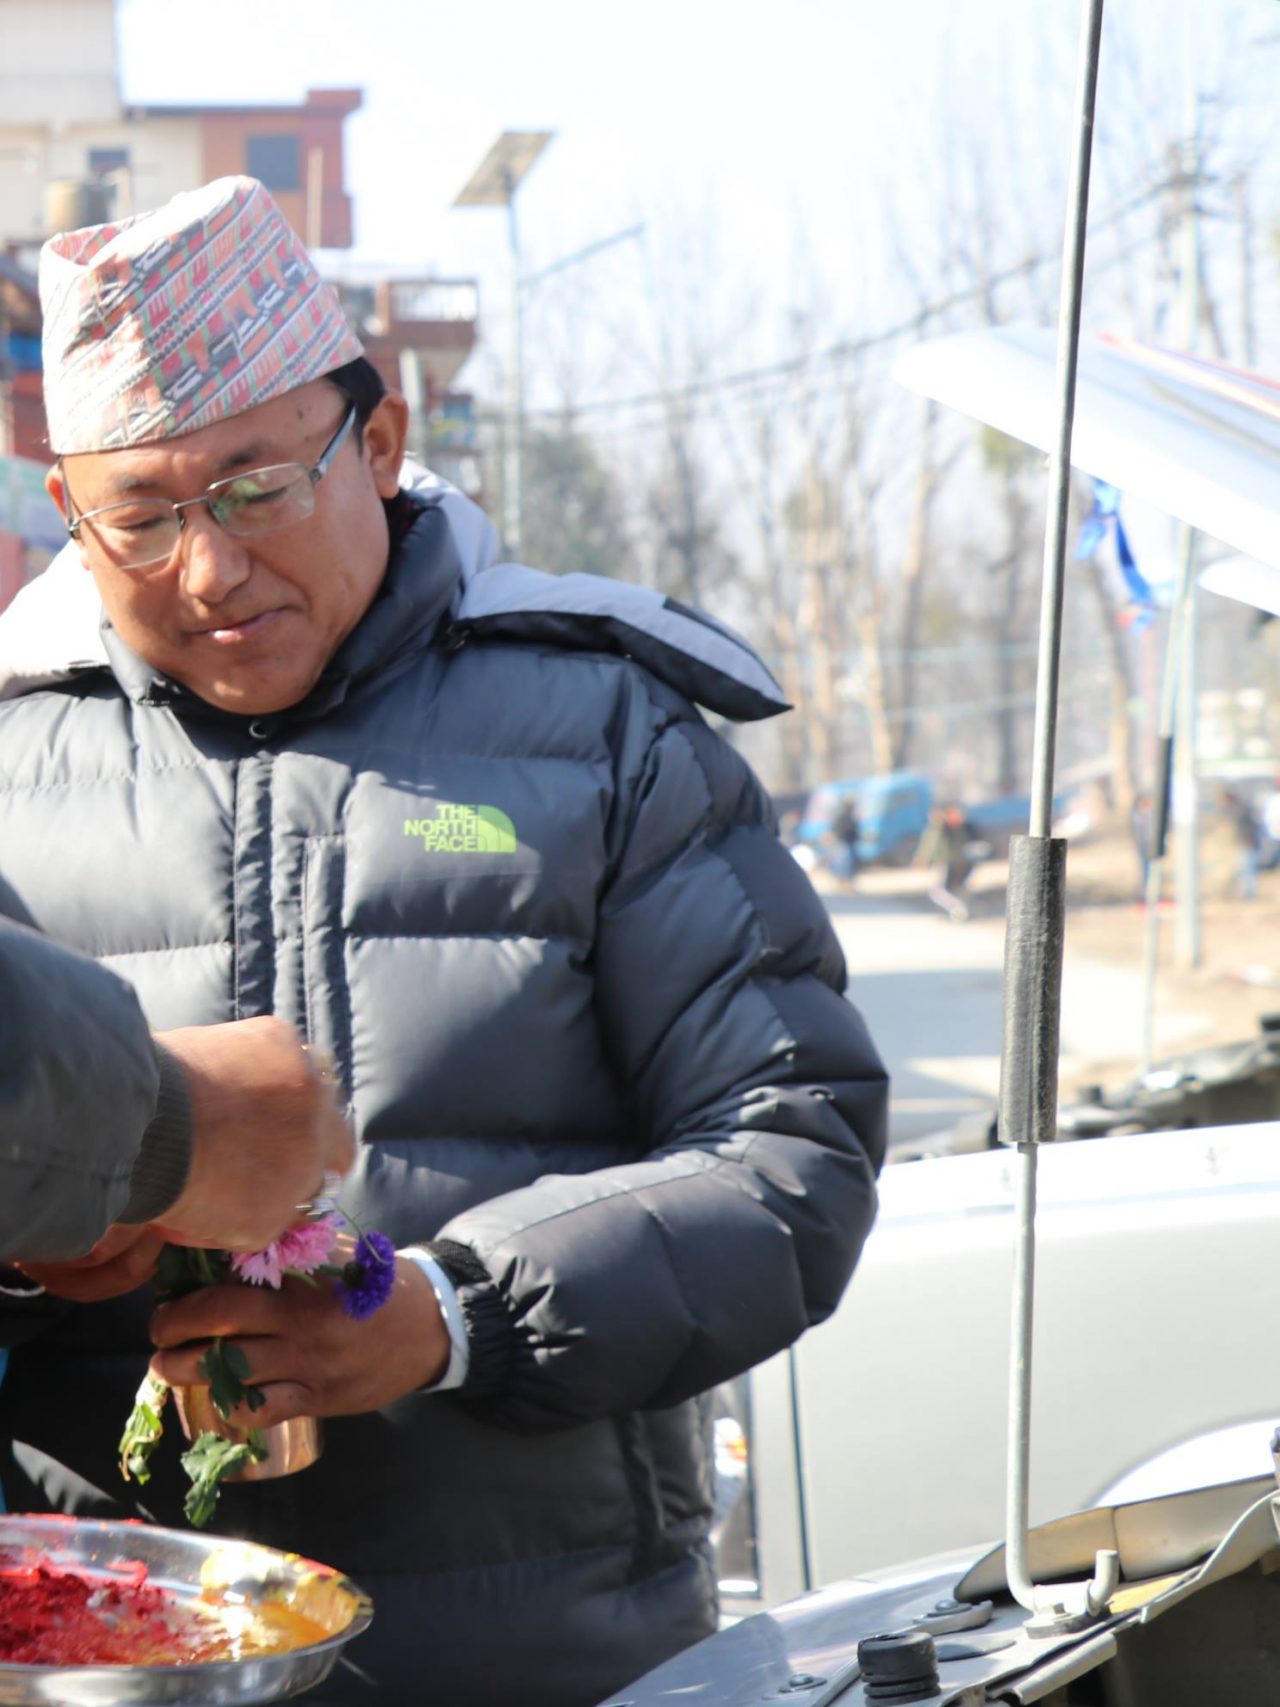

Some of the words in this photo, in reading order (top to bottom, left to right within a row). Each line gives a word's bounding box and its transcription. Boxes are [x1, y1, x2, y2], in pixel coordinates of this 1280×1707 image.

[435, 803, 477, 820] THE
[403, 819, 477, 836] NORTH
[424, 835, 477, 852] FACE
